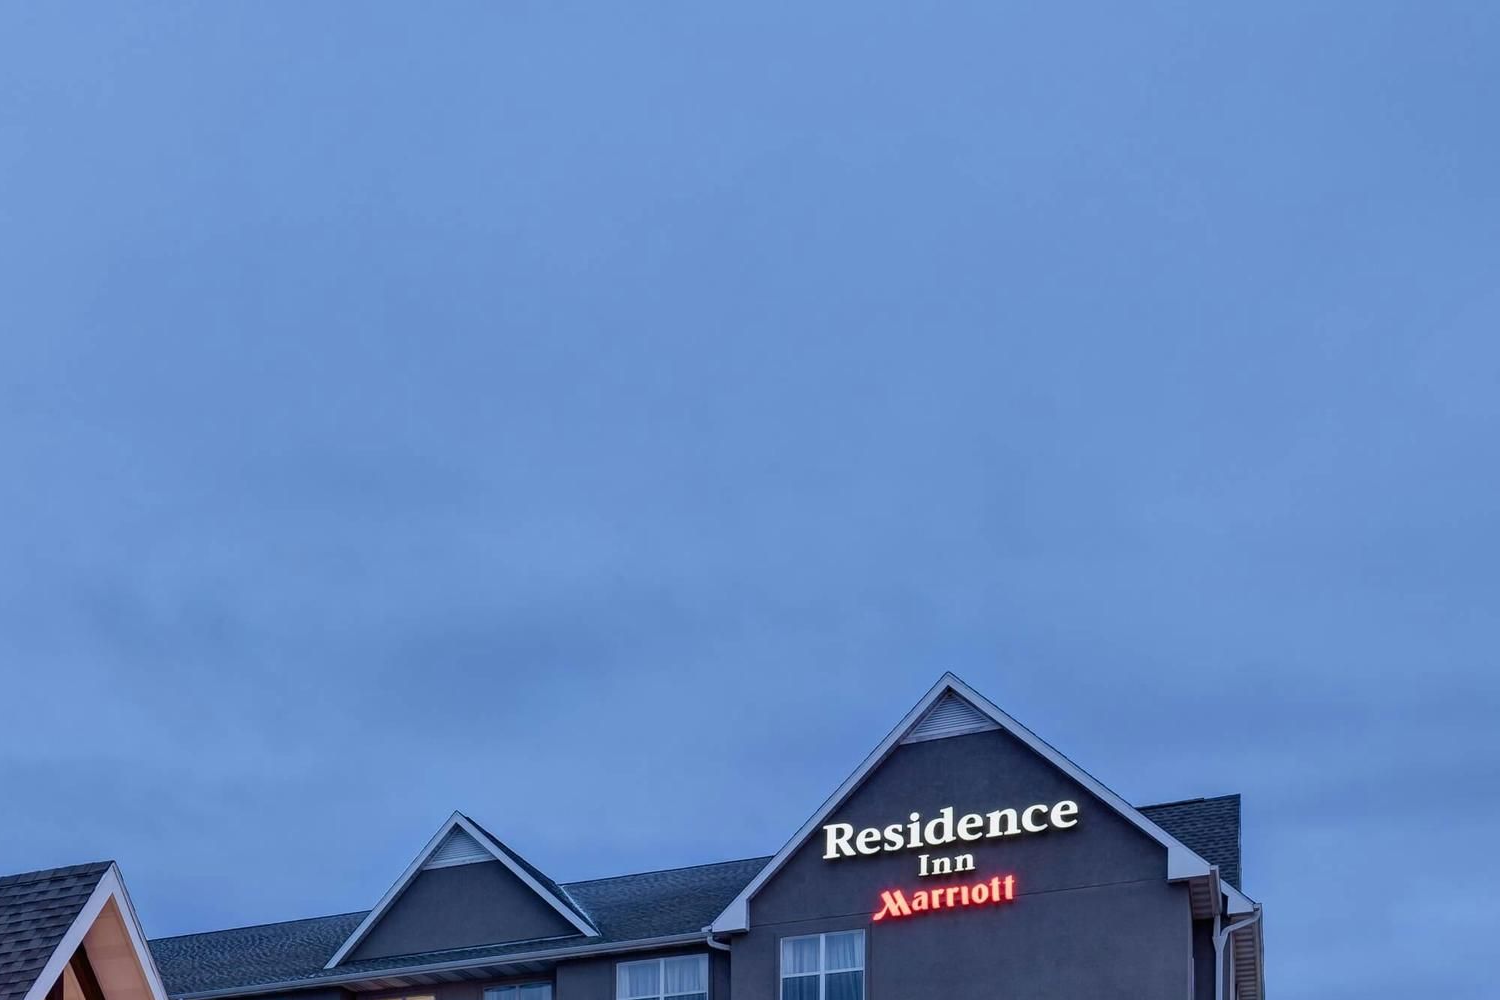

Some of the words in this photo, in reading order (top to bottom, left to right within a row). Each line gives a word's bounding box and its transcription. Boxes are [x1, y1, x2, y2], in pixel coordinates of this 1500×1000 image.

[822, 799, 1078, 859] Residence
[918, 852, 976, 877] Inn
[873, 875, 1015, 920] Marriott
